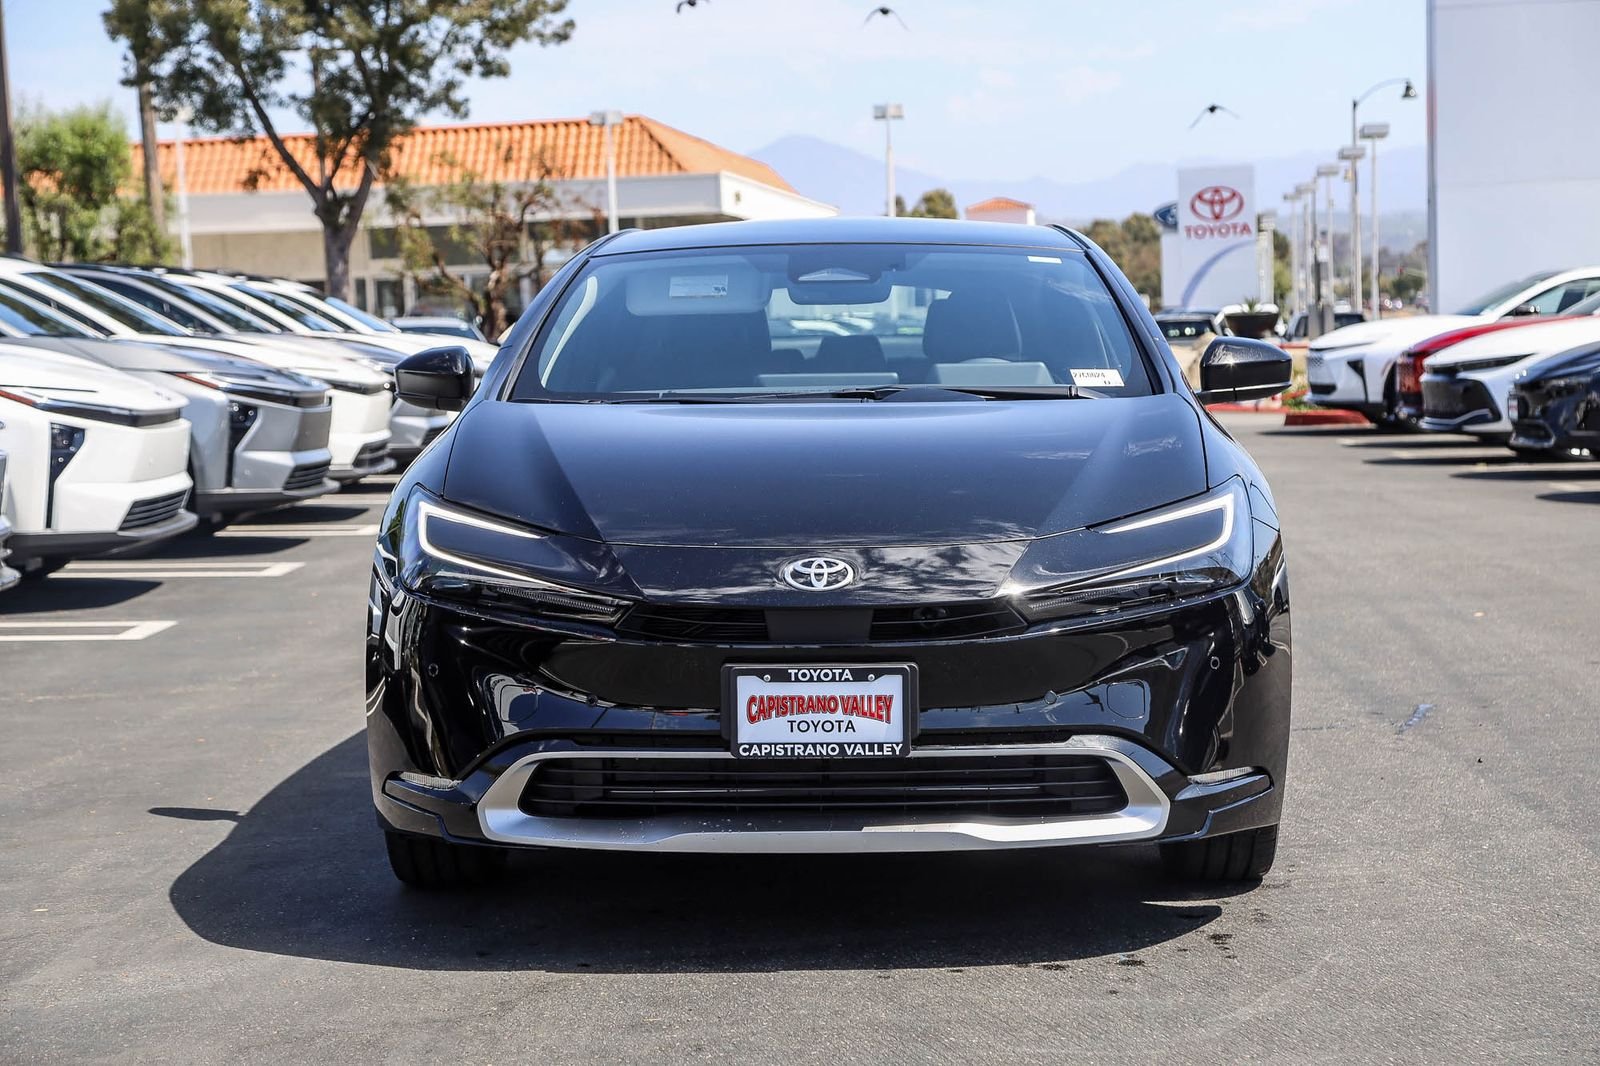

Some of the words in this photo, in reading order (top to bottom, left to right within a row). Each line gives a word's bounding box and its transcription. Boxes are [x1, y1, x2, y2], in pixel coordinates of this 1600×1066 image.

[1184, 222, 1252, 240] TOYOTA
[788, 669, 854, 682] TOYOTA
[746, 694, 839, 724] CAPISTRANO
[839, 694, 894, 724] VALLEY
[787, 720, 856, 733] TOYOTA
[738, 744, 839, 756] CAPISTRANO
[844, 743, 903, 756] VALLEY
